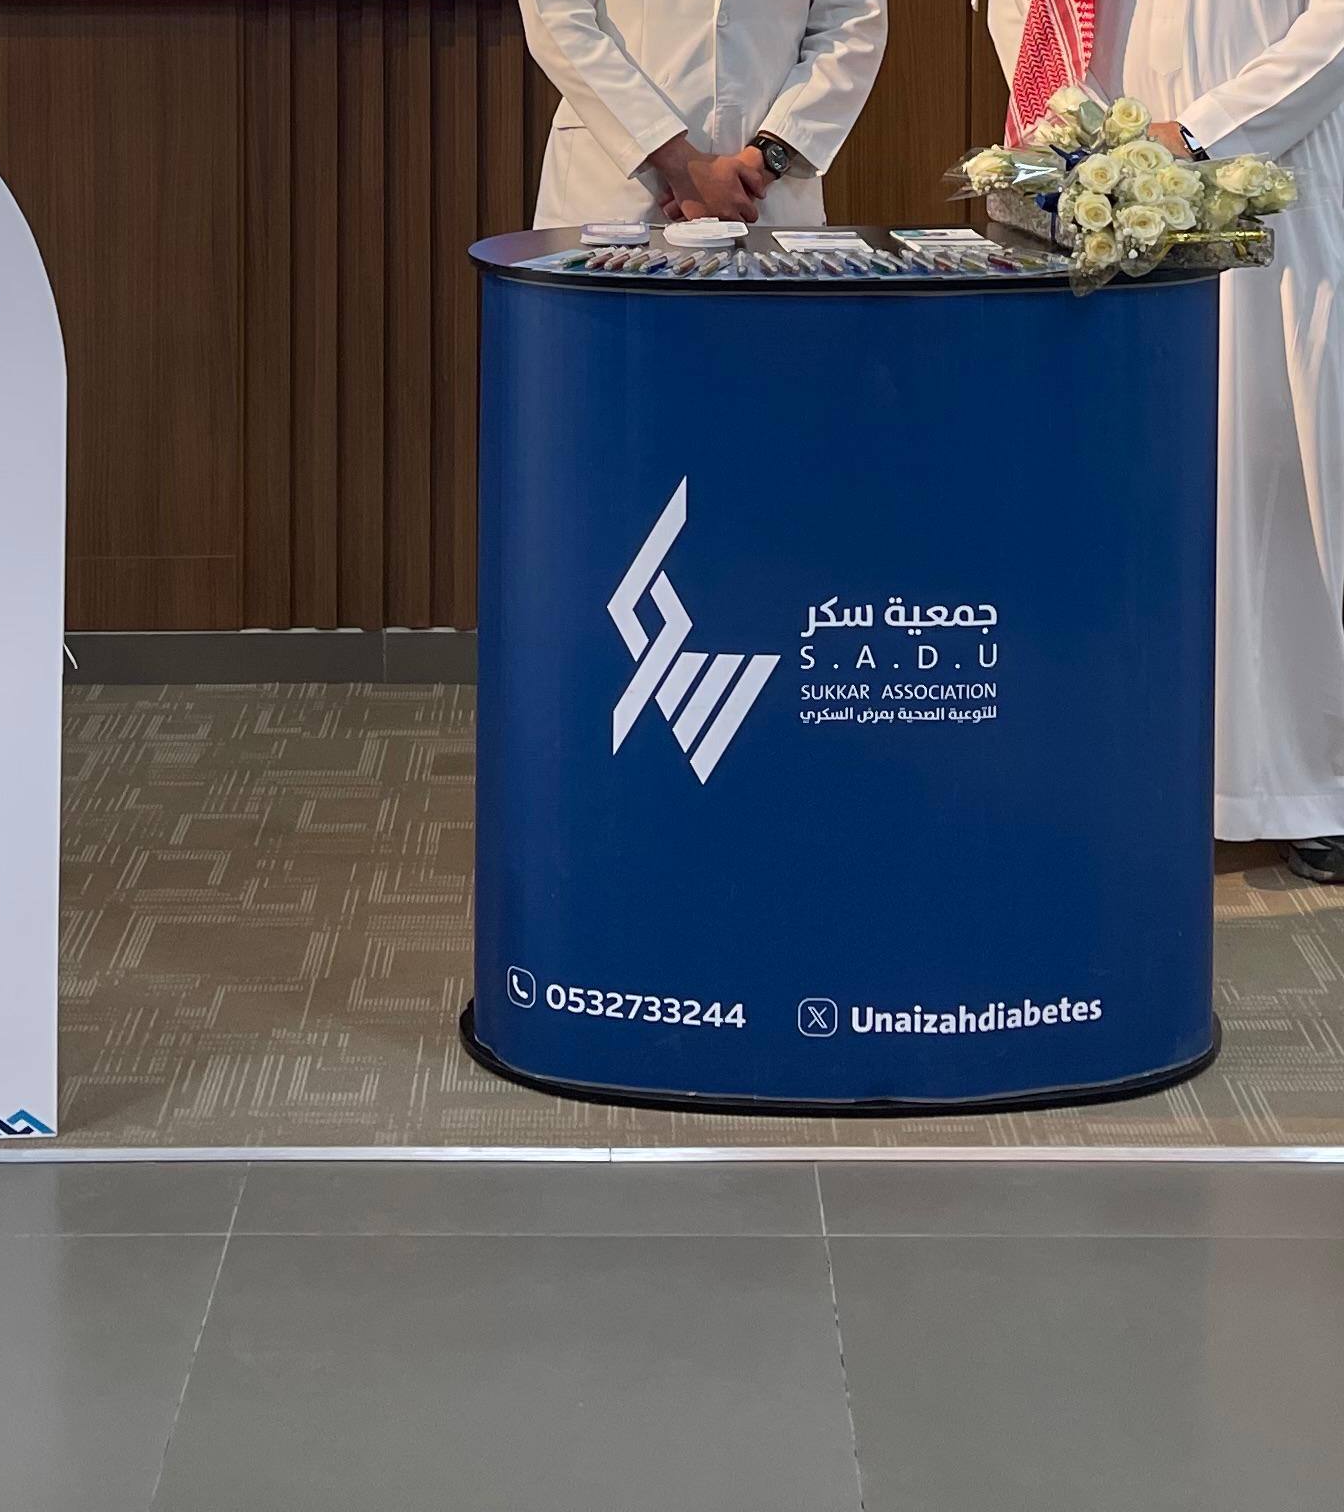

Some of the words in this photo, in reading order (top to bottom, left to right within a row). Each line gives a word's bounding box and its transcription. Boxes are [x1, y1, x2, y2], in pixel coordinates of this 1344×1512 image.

[801, 596, 873, 637] سكر
[885, 597, 997, 635] جمعية
[801, 684, 869, 699] SUKKAR
[882, 683, 996, 700] ASSOCIATION
[800, 707, 853, 724] السكري
[857, 708, 894, 723] بمرض
[898, 708, 944, 723] الصحية
[949, 706, 996, 723] للتوعية
[547, 984, 746, 1028] 0532733244
[852, 997, 1101, 1033] Unaizahdiabetes
